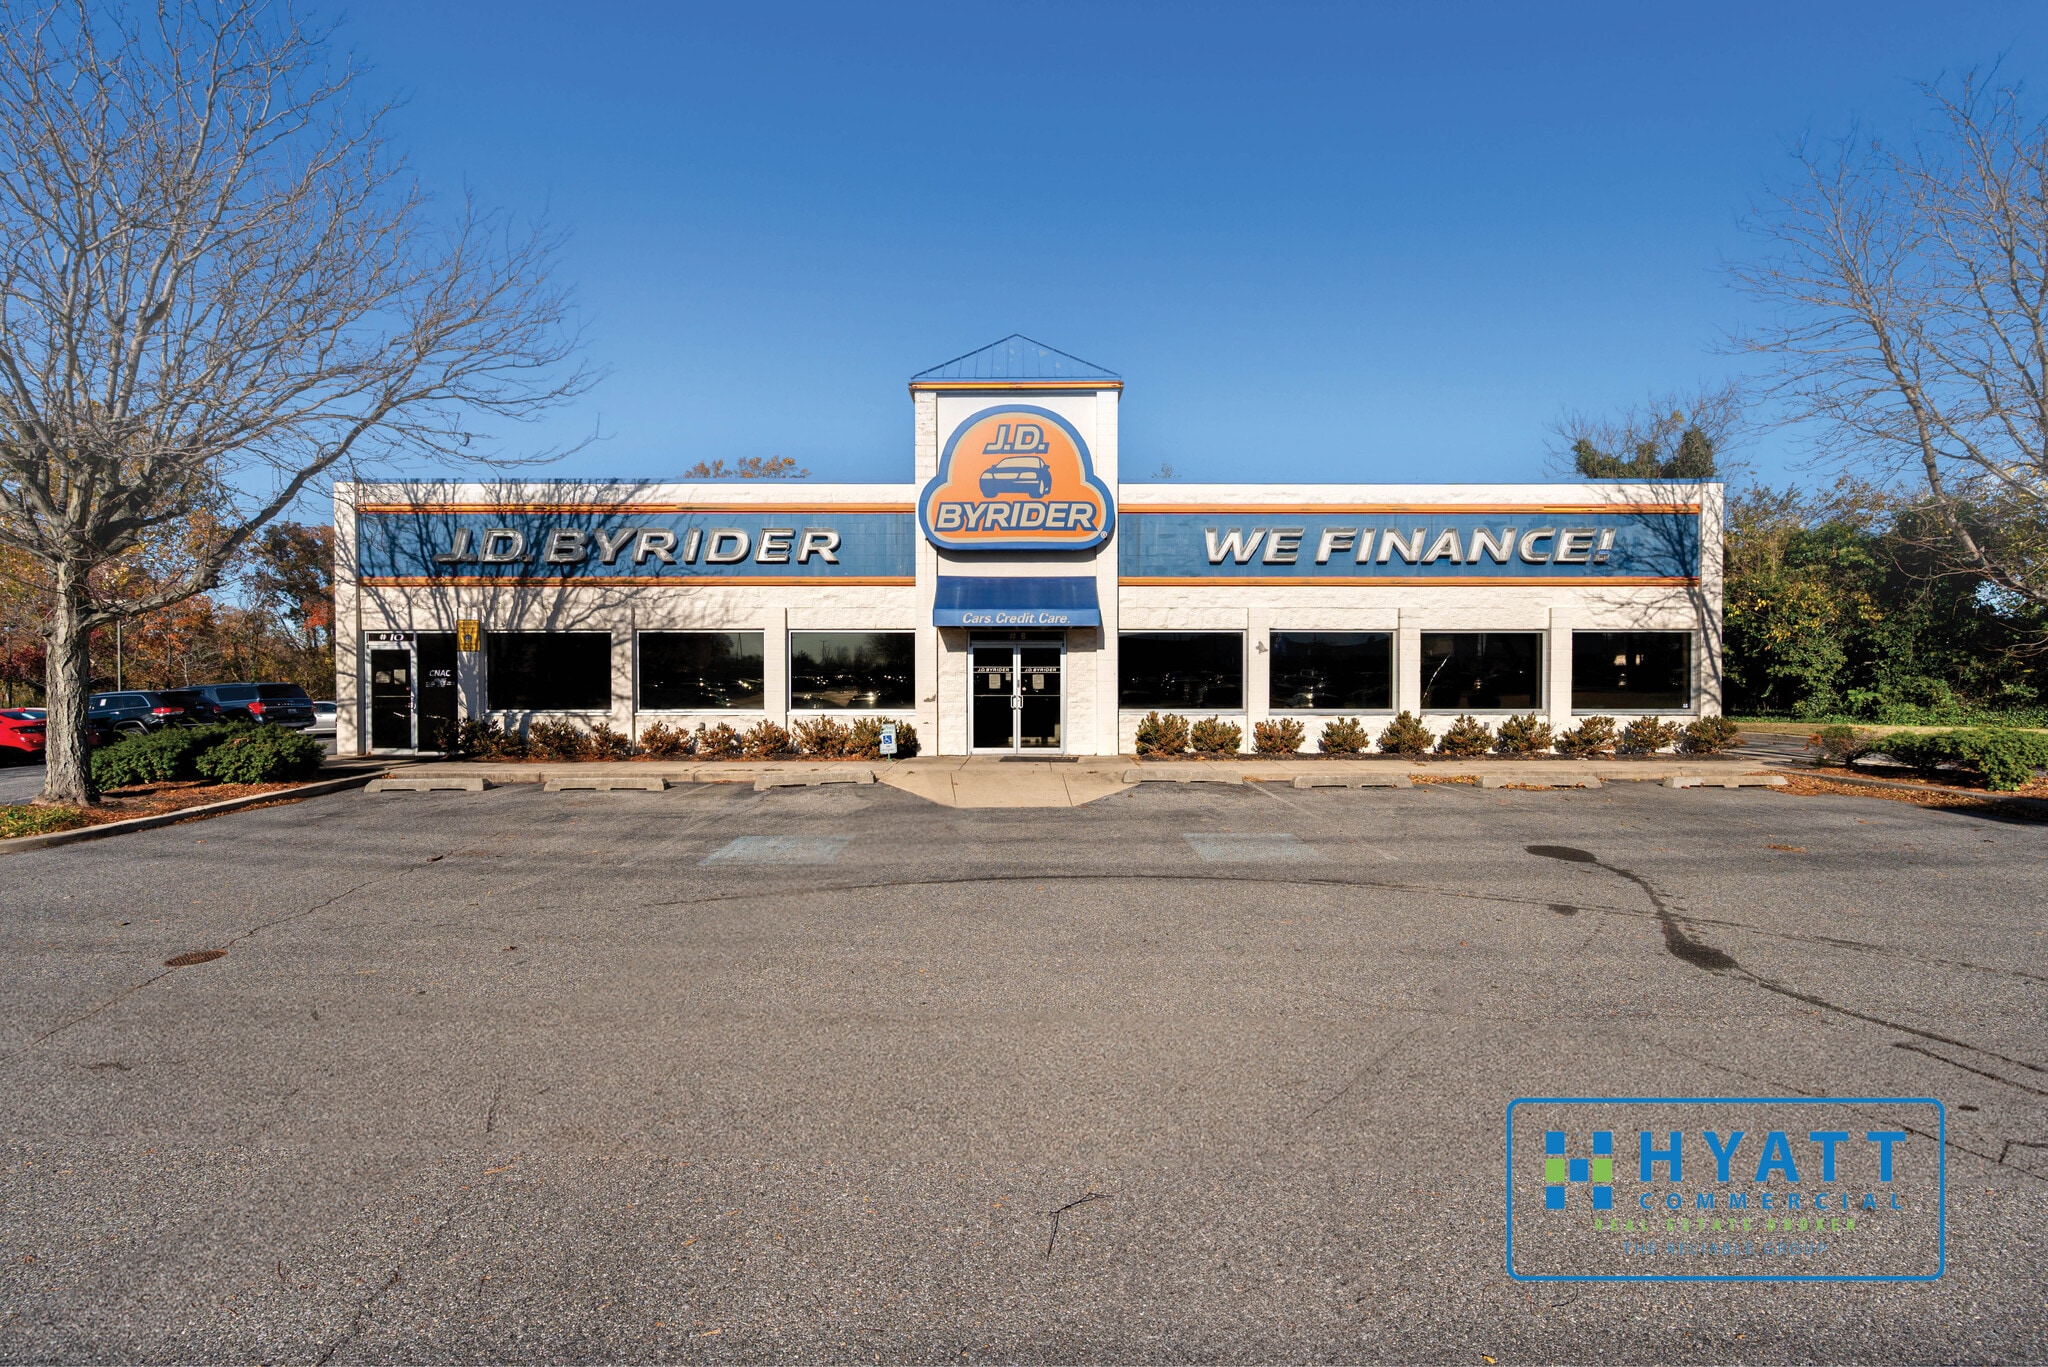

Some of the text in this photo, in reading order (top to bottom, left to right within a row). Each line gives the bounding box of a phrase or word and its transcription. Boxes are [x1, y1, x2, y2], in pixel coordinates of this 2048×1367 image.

[983, 424, 1049, 454] J.D.
[934, 501, 1098, 532] BYRIDER
[543, 527, 842, 564] BYRIDER
[1205, 527, 1617, 564] WE FINANCE!
[962, 612, 1070, 624] Cars. Credit. Care.
[429, 669, 451, 677] CNAC
